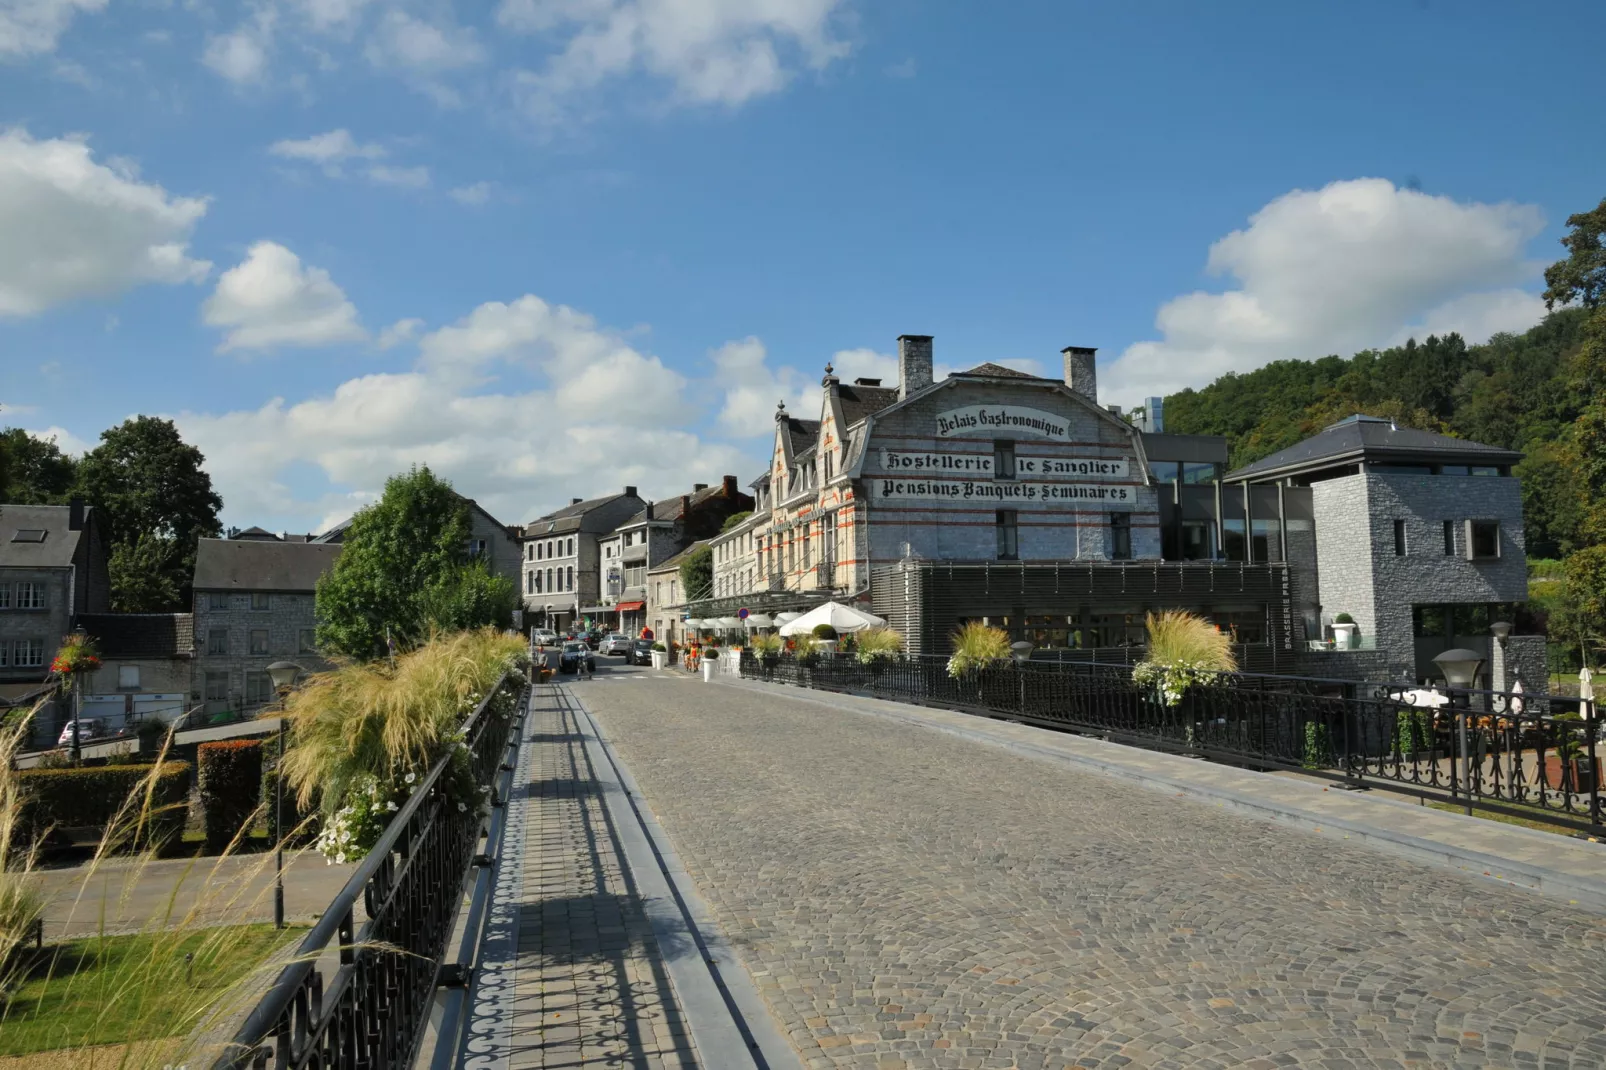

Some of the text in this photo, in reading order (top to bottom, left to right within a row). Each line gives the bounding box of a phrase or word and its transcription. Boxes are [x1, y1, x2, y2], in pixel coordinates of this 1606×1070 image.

[938, 409, 1064, 436] Relais Gastronomique
[887, 453, 1120, 475] Hostellerie le Sanglier
[882, 479, 959, 498] Pensions
[961, 482, 1036, 500] Banquets
[1283, 599, 1292, 650] BRASSERIE
